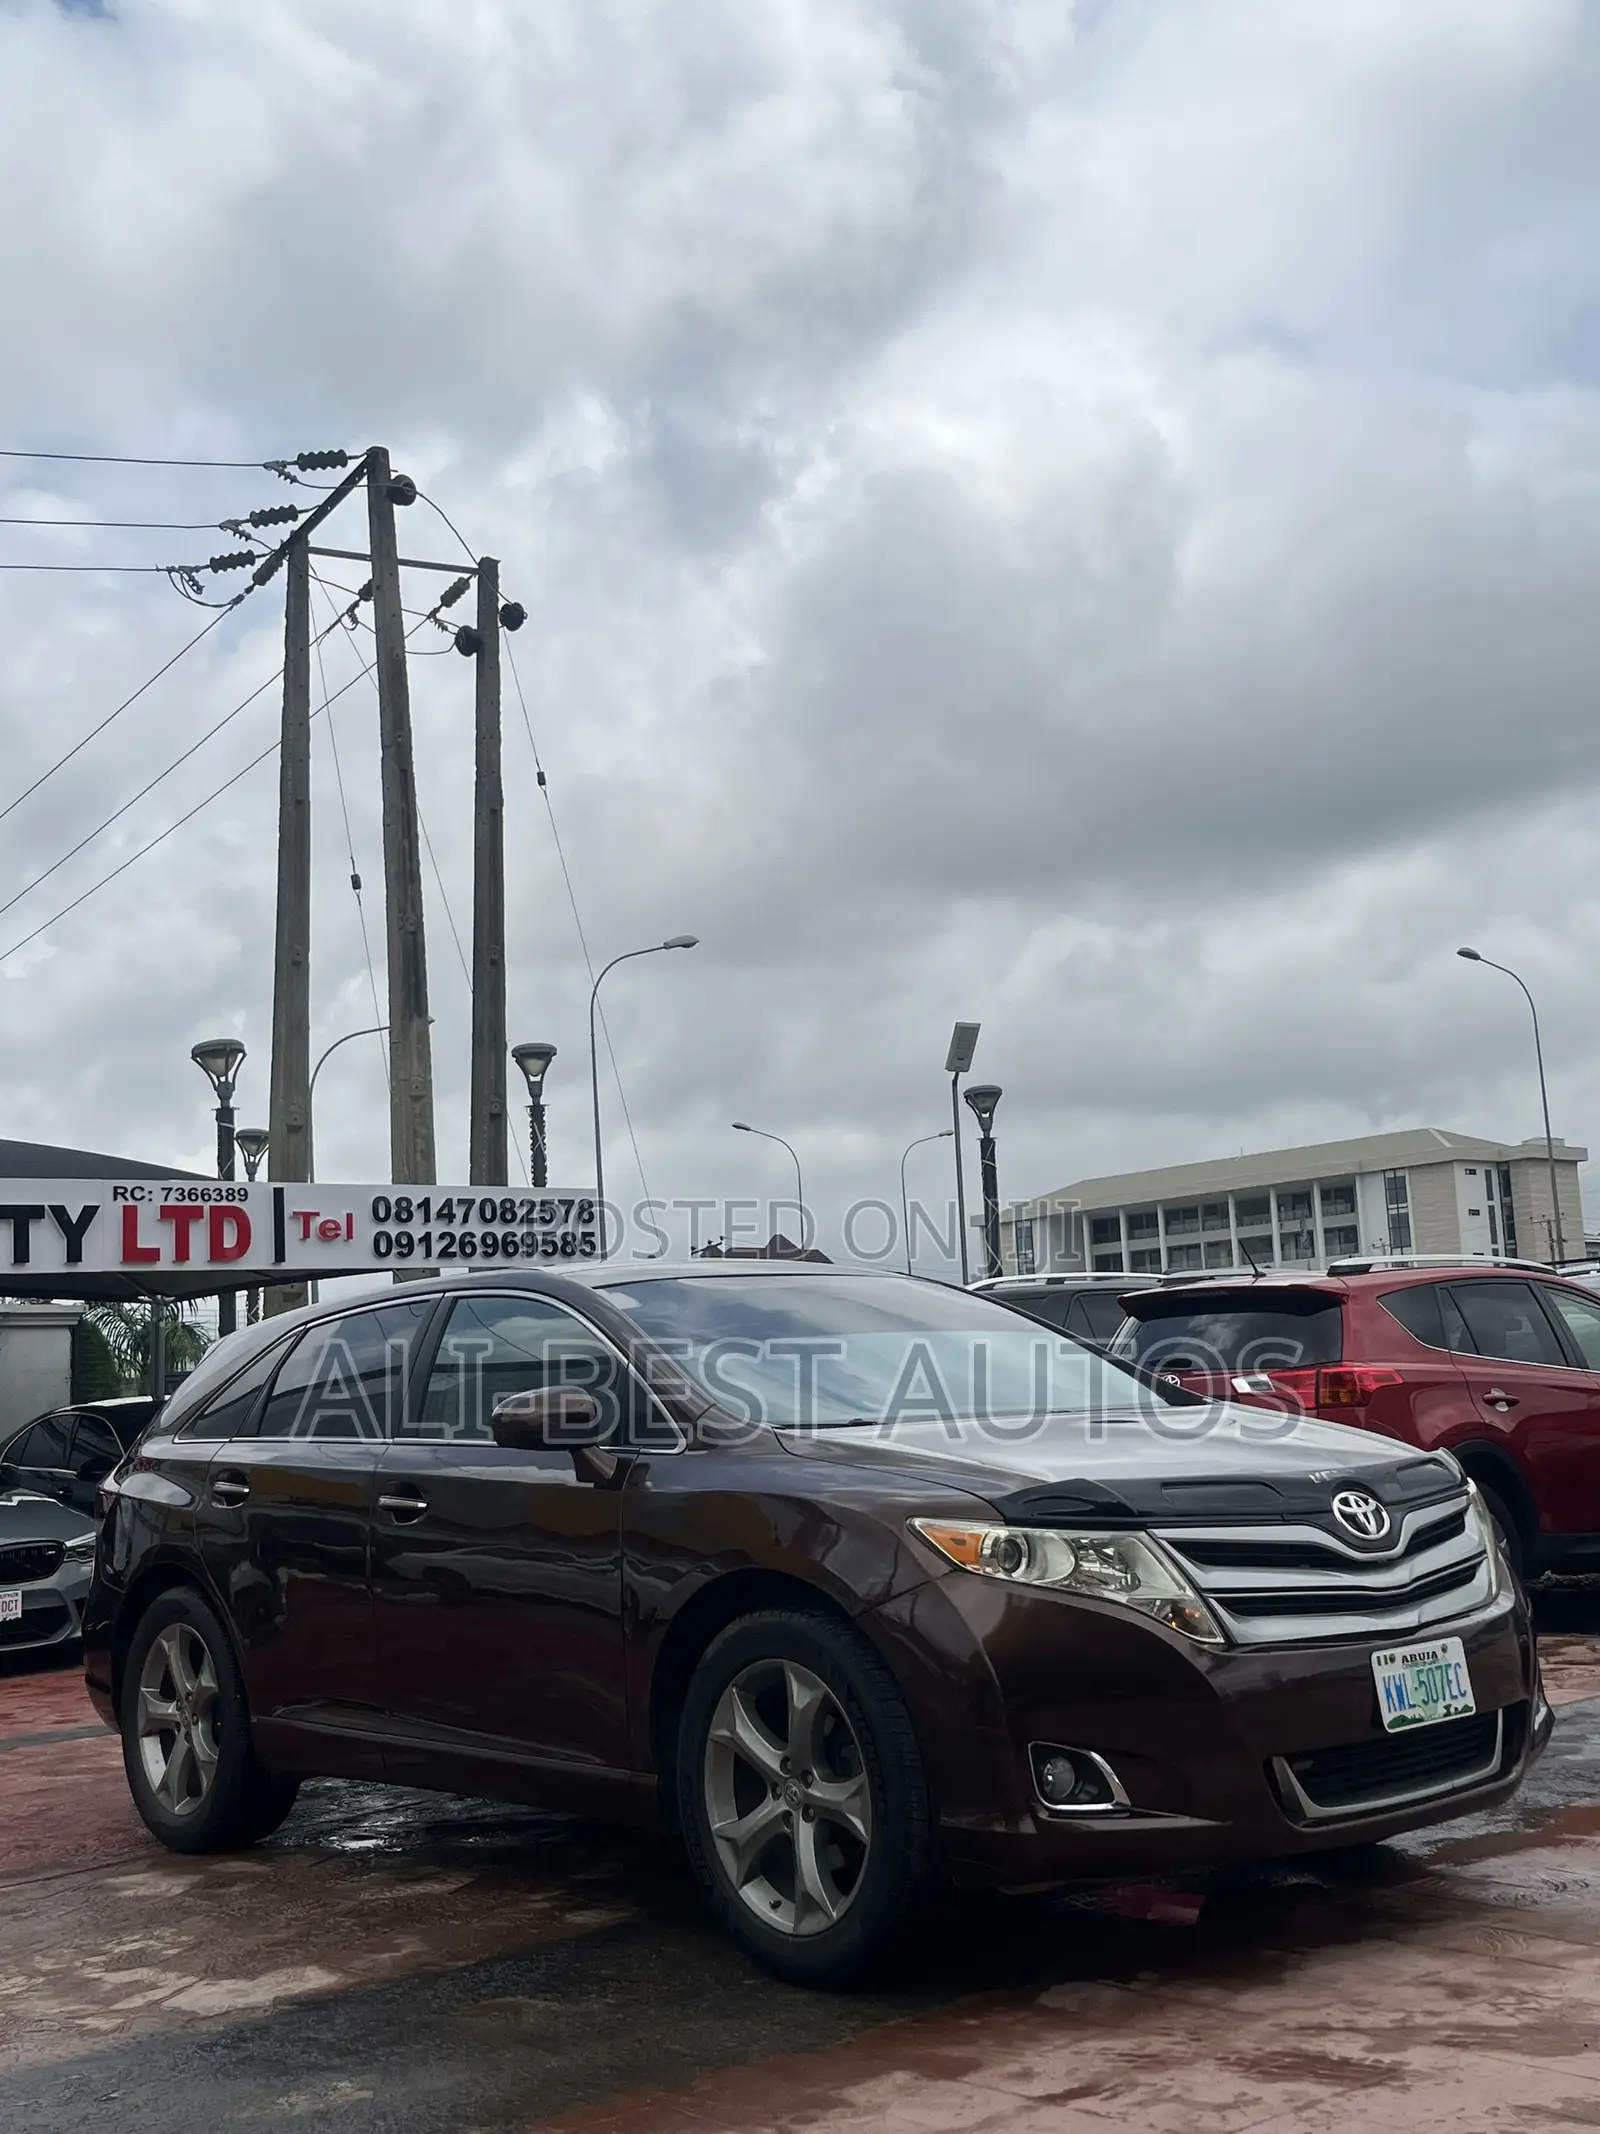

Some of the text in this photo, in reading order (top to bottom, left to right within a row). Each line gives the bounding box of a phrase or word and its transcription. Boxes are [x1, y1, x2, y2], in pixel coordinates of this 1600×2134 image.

[112, 1185, 249, 1202] RC: 7366389
[372, 1196, 596, 1225] 08147082578
[0, 1204, 252, 1264] TY LTD
[291, 1211, 354, 1241] Tel
[373, 1230, 597, 1259] 09126969585
